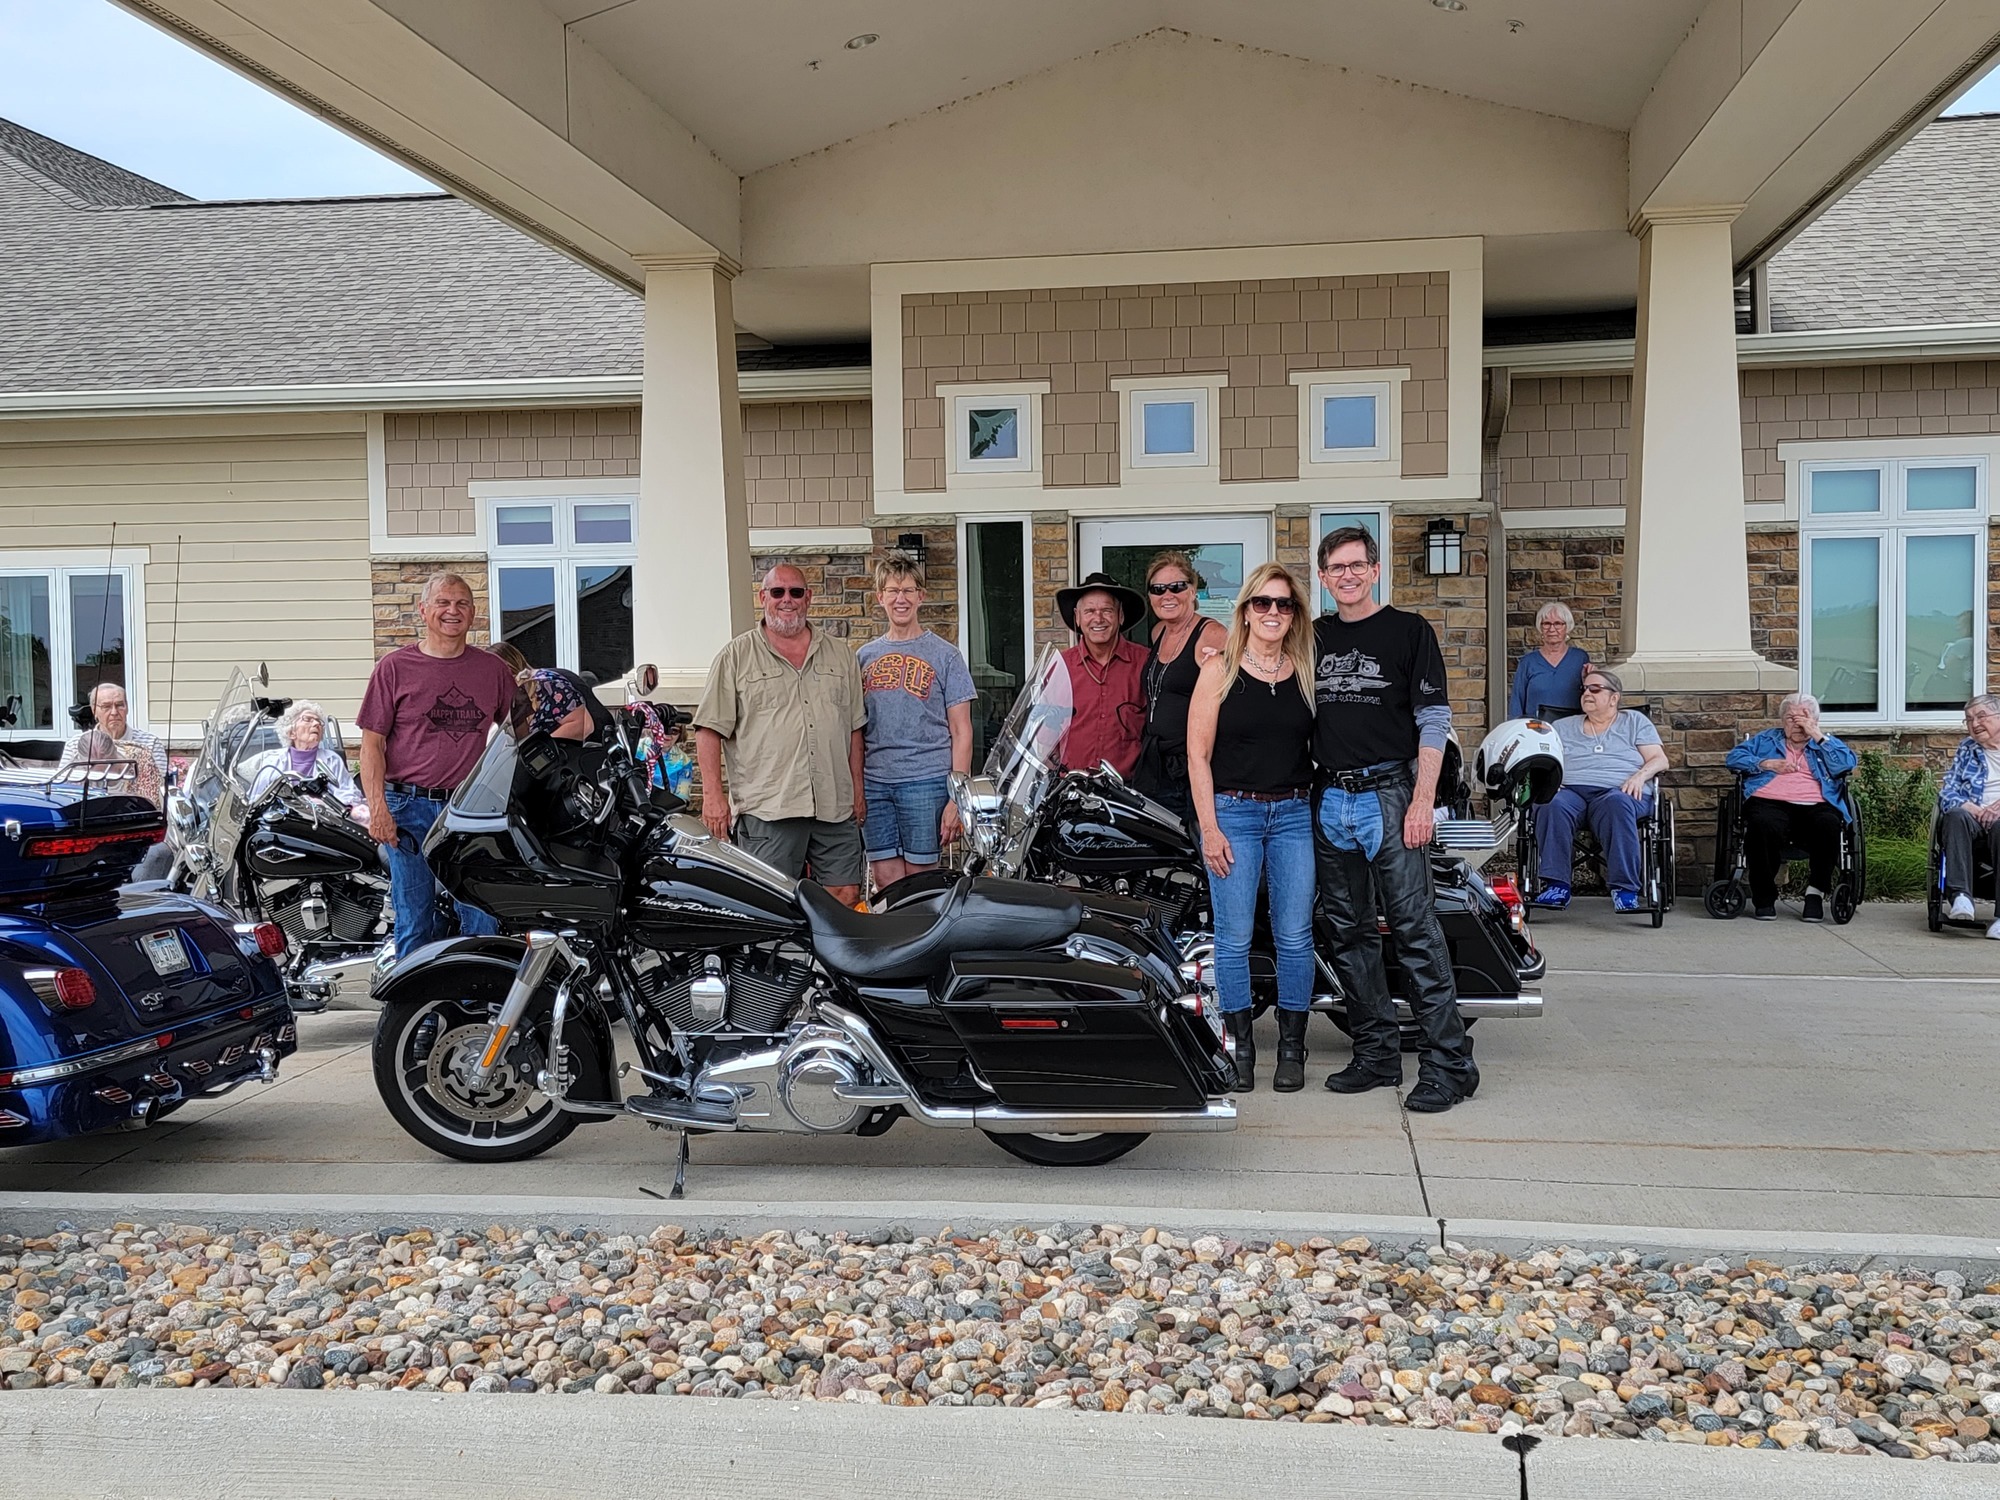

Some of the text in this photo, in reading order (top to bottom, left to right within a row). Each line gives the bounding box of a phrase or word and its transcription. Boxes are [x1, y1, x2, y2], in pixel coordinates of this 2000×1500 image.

[430, 708, 483, 719] HAPPY TRAILS
[1066, 840, 1153, 851] Harley-Davidson
[635, 896, 755, 920] Harley-Davidson
